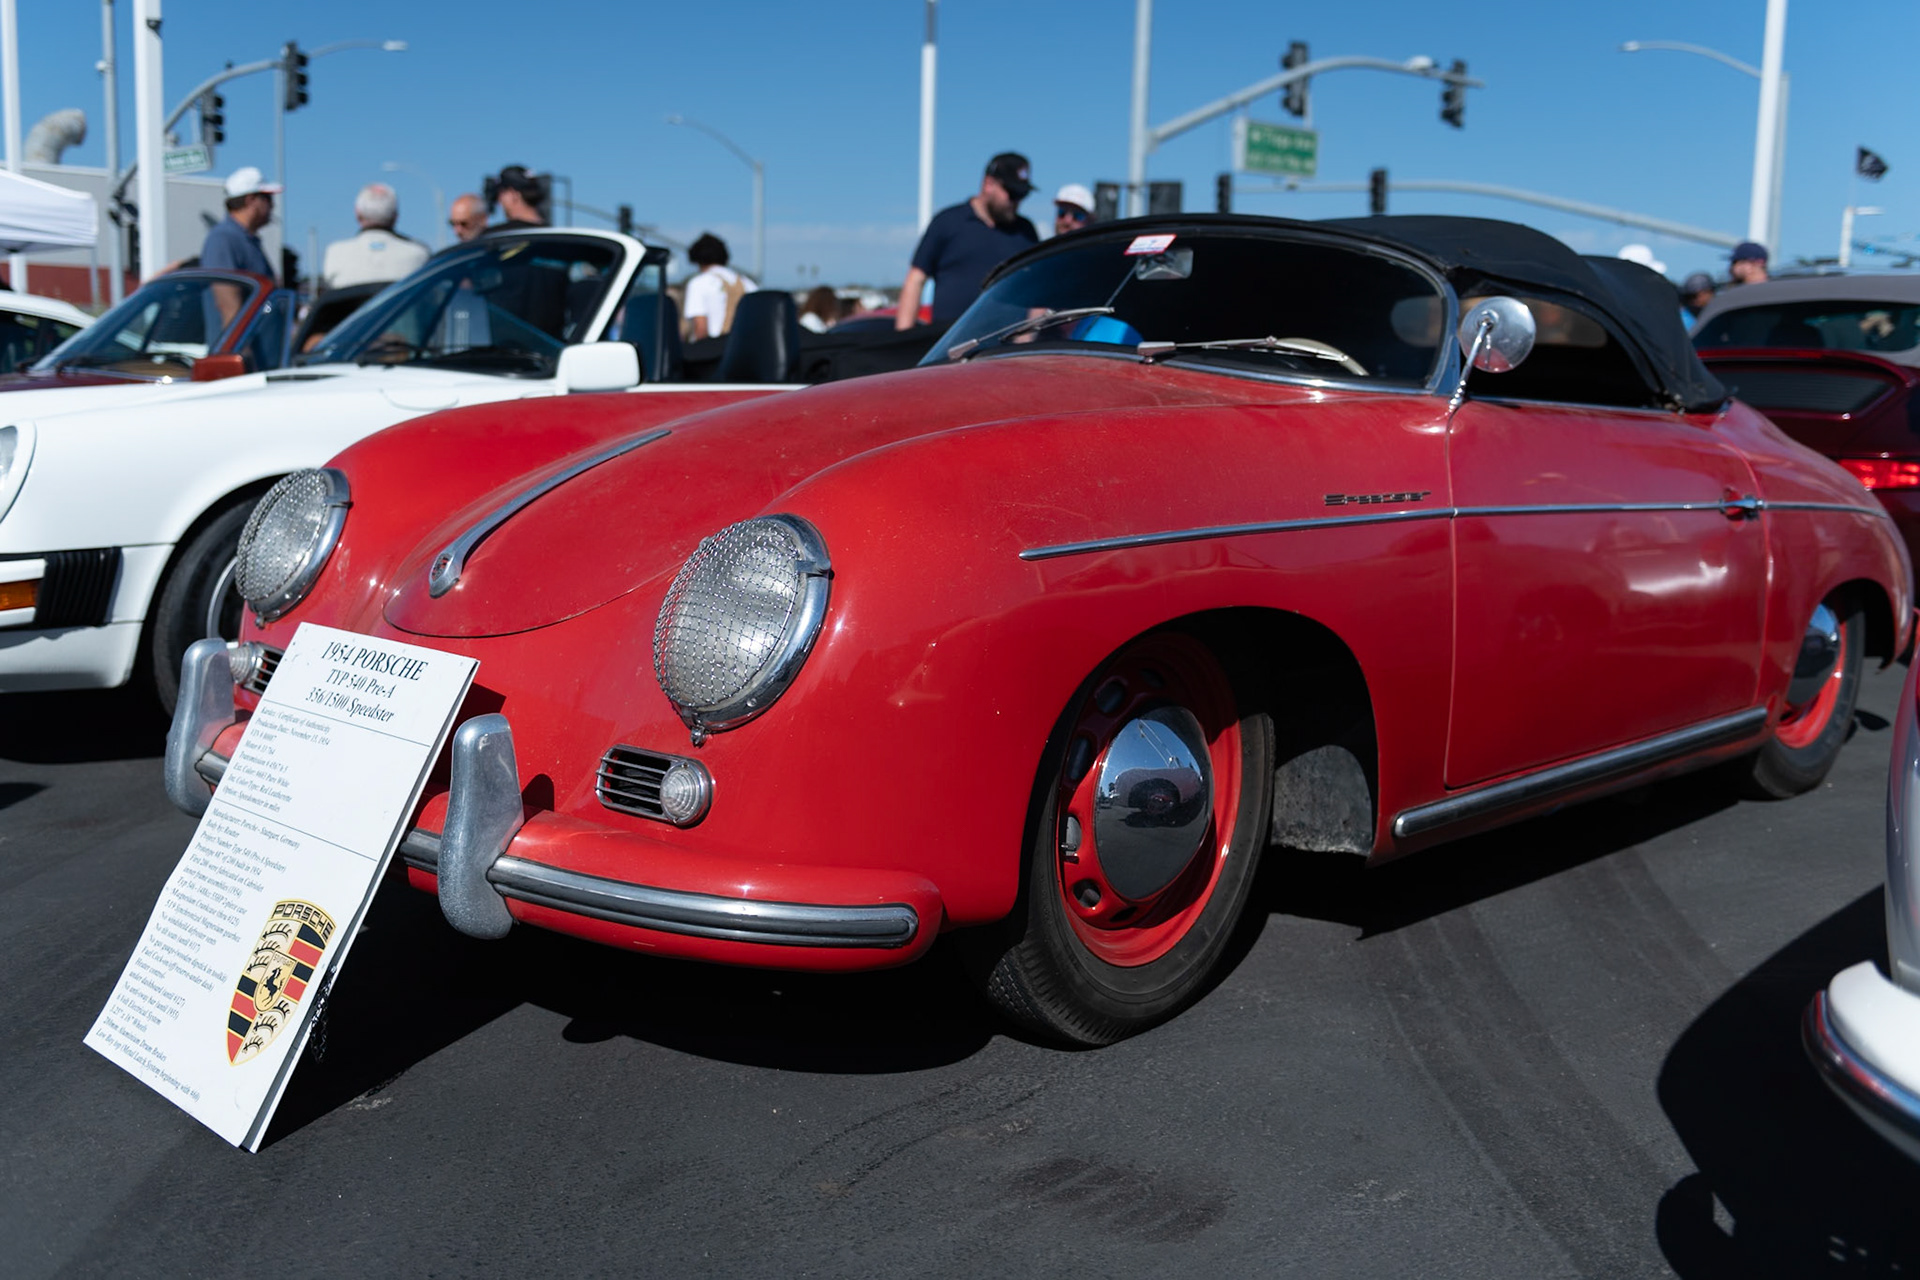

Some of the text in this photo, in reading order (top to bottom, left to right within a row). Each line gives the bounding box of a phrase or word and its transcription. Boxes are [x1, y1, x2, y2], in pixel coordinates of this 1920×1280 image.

[321, 641, 428, 680] 1954 PORSCHE
[326, 668, 396, 698] TYP 540 Pre-A
[305, 687, 394, 722] 356/1500 Speedster
[271, 903, 334, 942] PORSCHE
